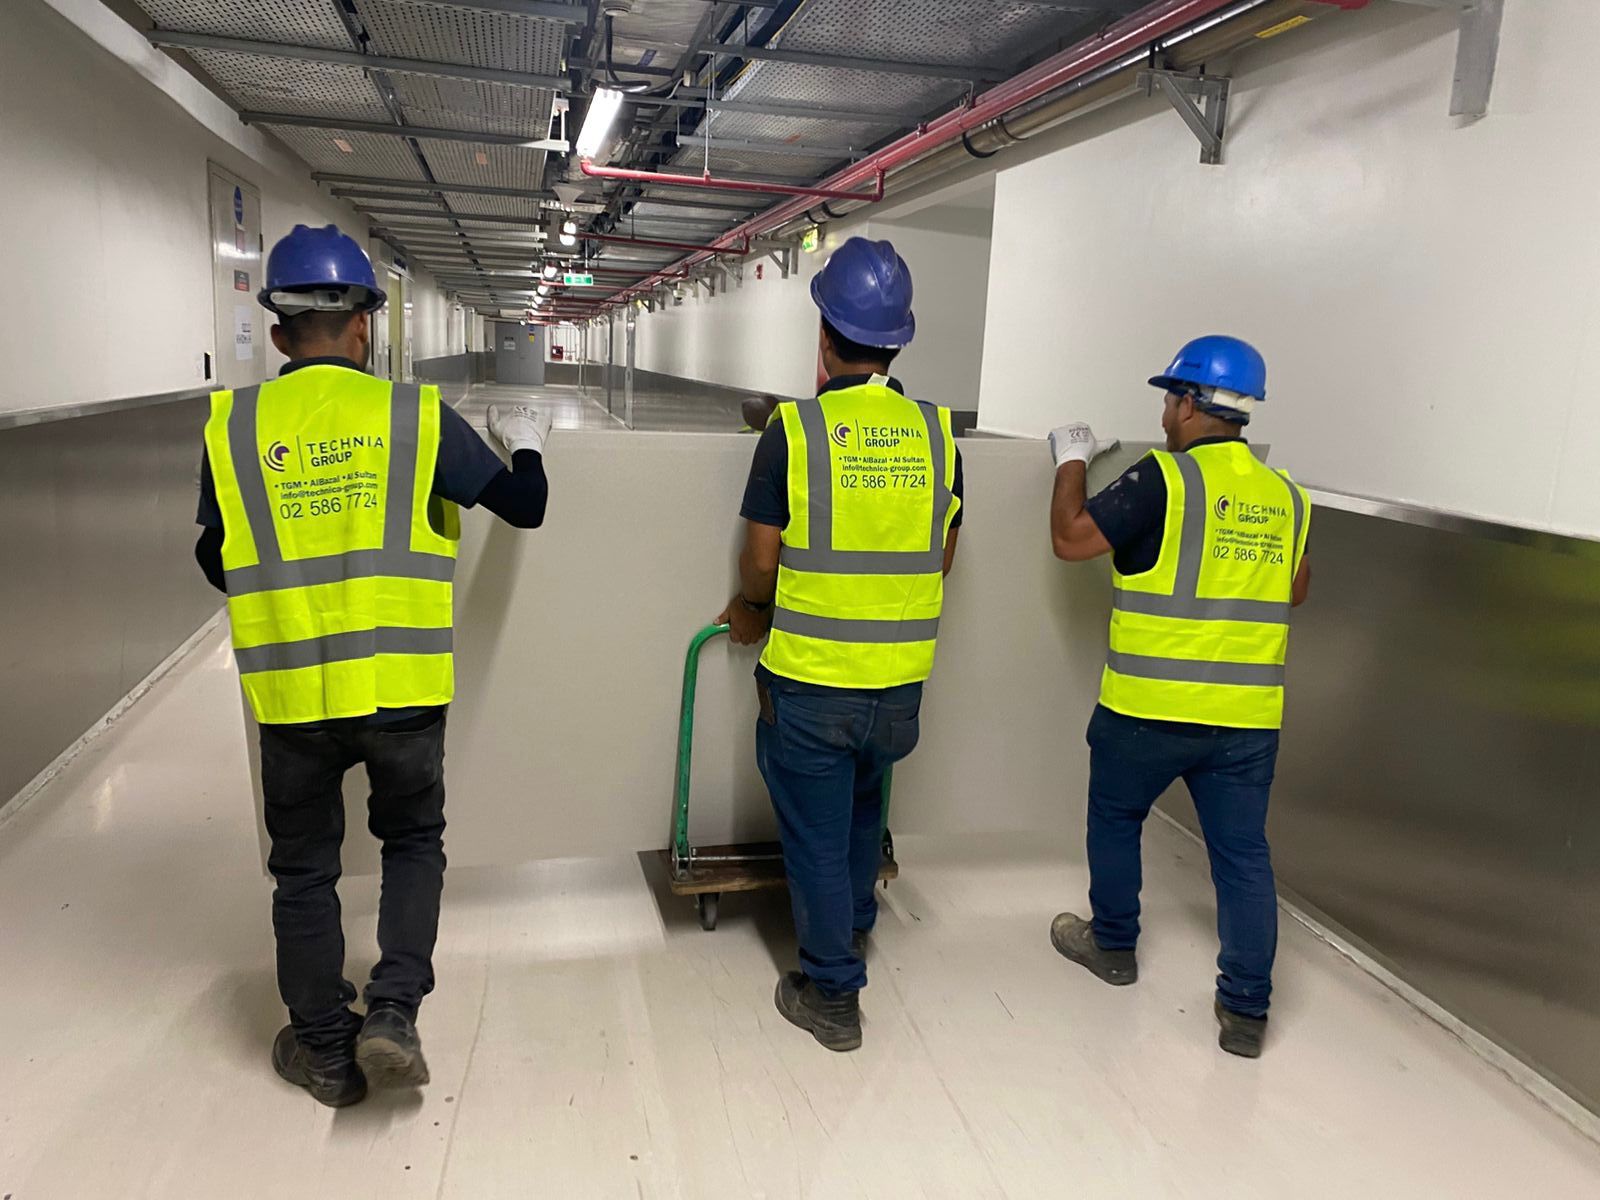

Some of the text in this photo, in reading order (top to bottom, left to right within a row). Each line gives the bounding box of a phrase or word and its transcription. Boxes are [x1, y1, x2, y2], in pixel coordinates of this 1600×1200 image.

[863, 427, 922, 439] TECHNIA
[306, 436, 384, 454] TECHNIA
[865, 438, 900, 448] GROUP
[311, 451, 353, 467] GROUP
[280, 481, 302, 490] TGM
[840, 474, 926, 488] 02 586 7724
[280, 492, 377, 519] 02 586 7724
[1238, 503, 1287, 517] TECHNIA
[1238, 514, 1269, 524] GROUP
[1212, 545, 1284, 565] 02 586 7724
